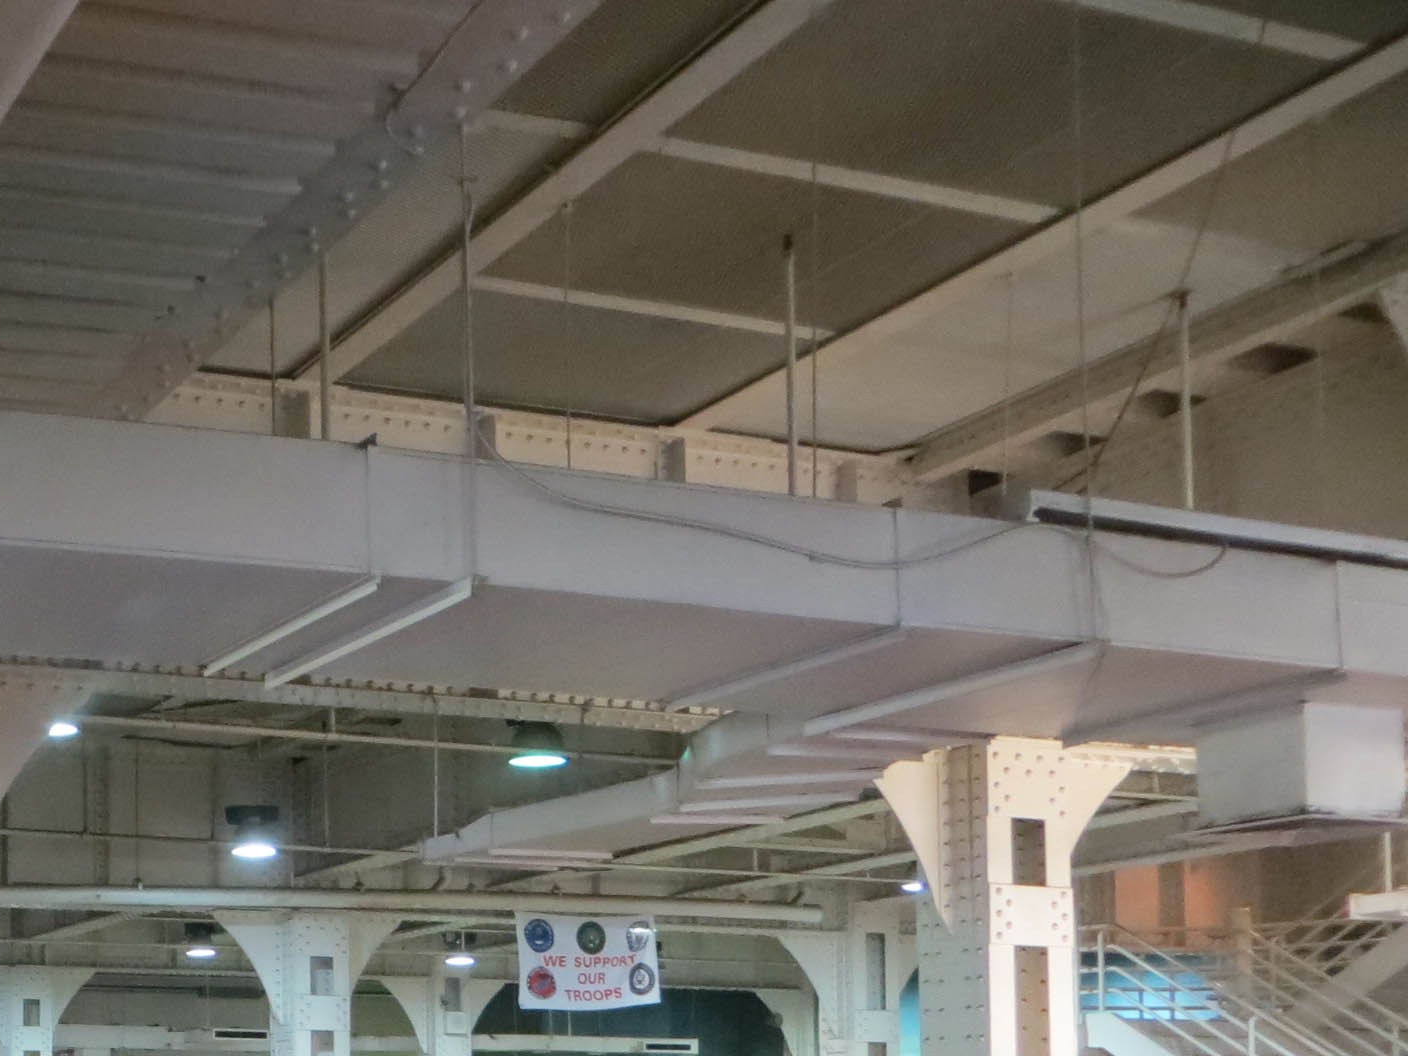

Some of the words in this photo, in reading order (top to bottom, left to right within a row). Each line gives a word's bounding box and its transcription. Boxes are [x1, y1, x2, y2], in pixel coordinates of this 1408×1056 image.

[543, 955, 567, 967] WE
[574, 954, 637, 968] SUPPORT
[577, 972, 606, 984] OUR
[564, 987, 623, 1002] TROOPS
